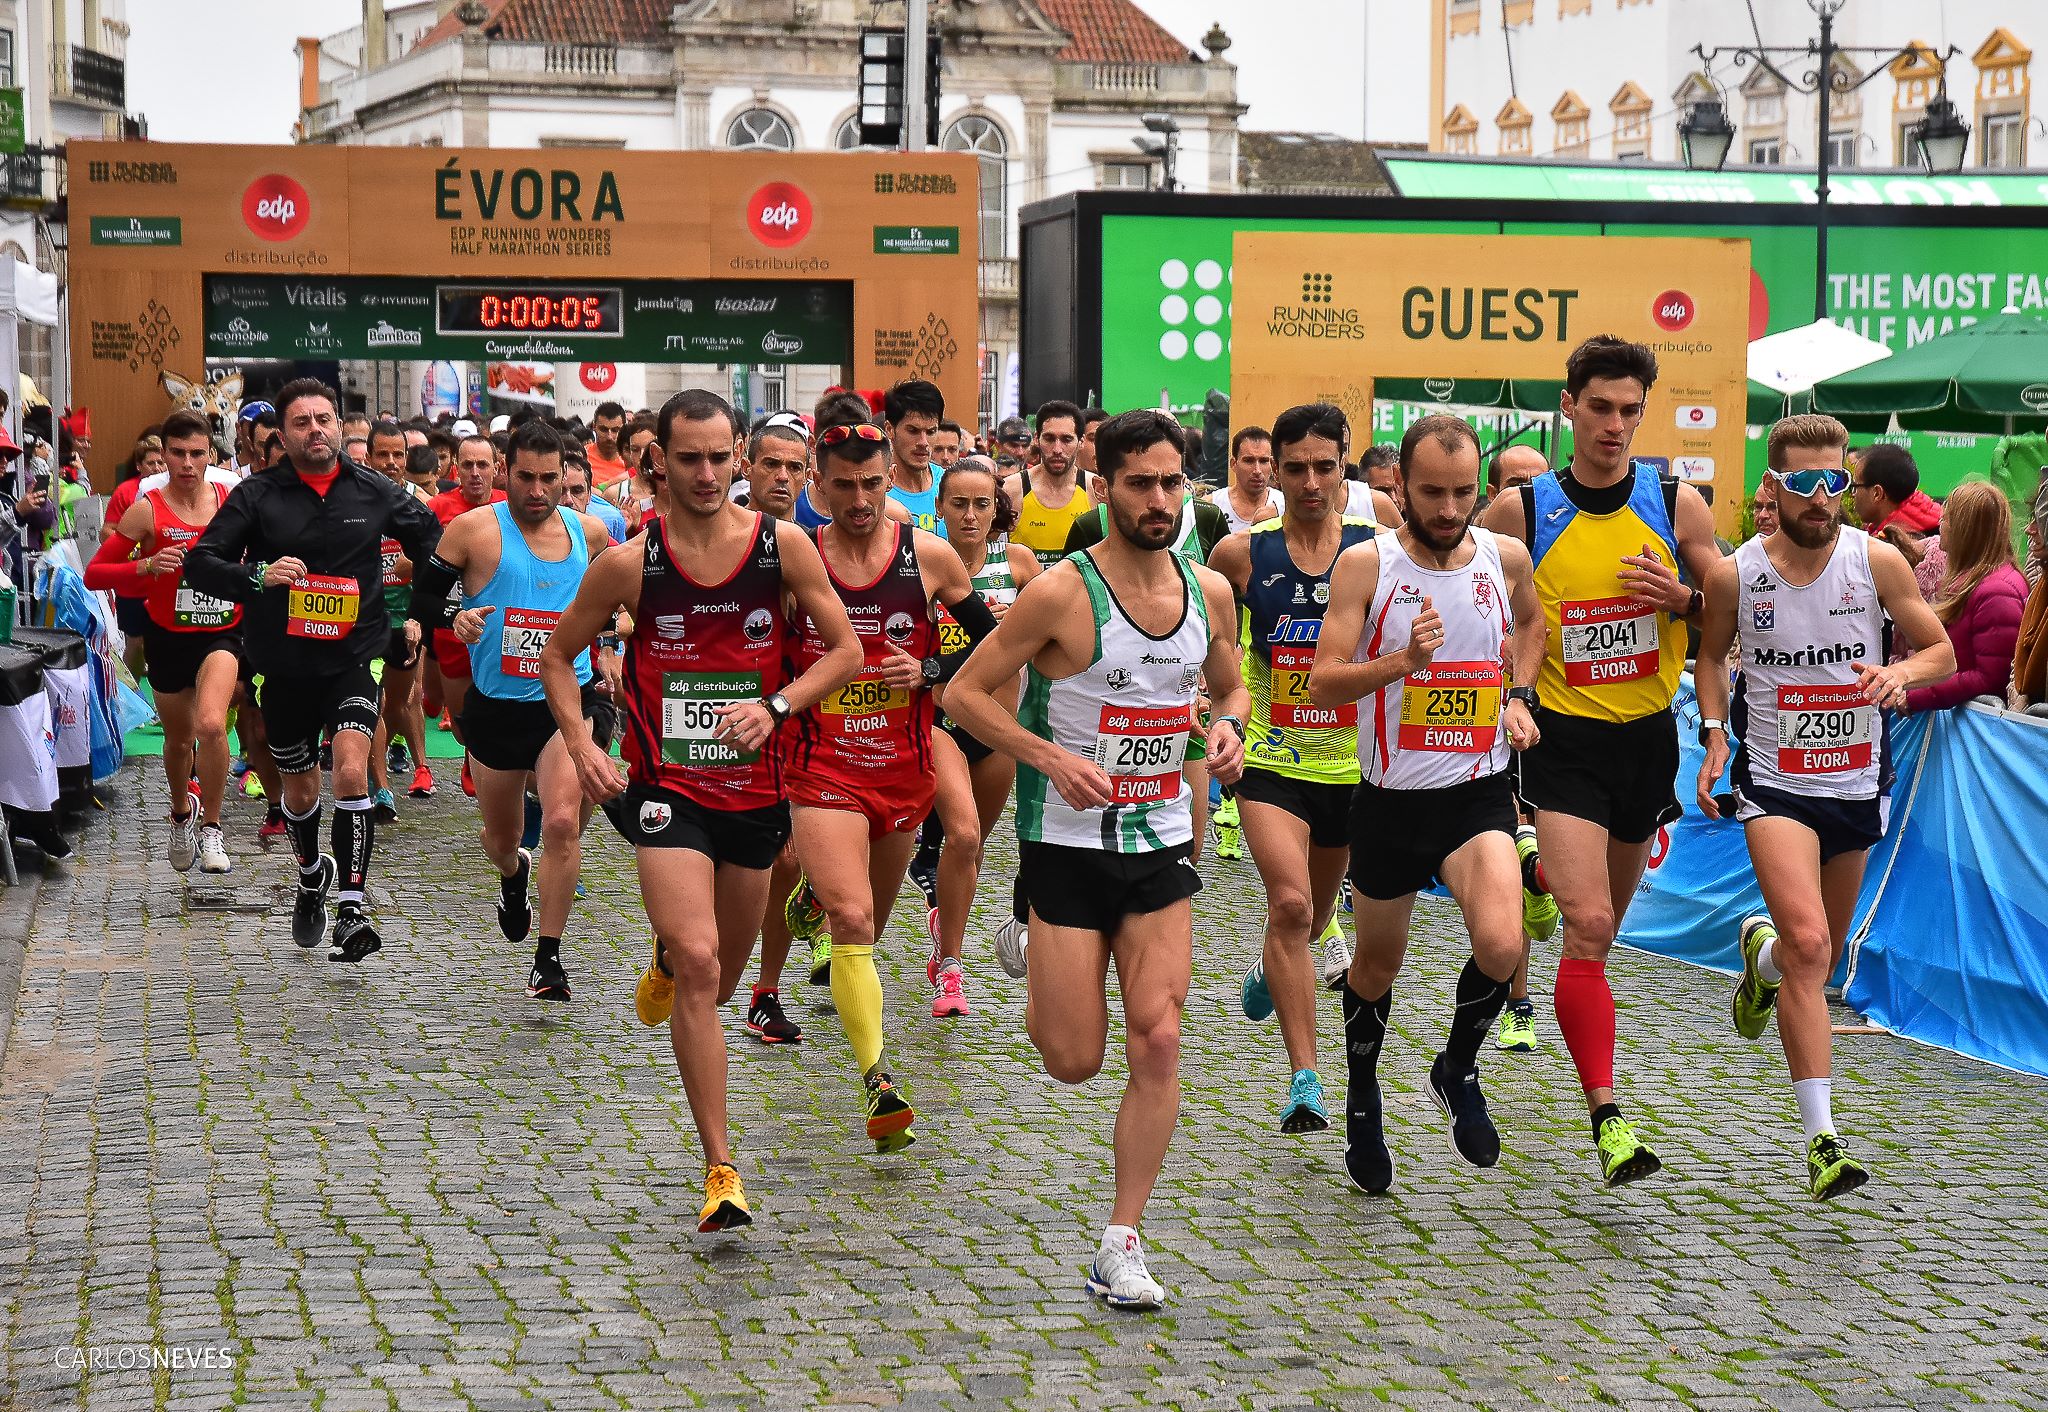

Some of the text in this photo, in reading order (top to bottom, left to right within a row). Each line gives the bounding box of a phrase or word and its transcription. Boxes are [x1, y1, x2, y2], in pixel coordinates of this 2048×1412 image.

[435, 156, 625, 222] ÉVORA
[257, 195, 295, 224] edp
[761, 202, 799, 231] edp
[451, 227, 611, 241] EDP RUNNING WONDERS
[451, 242, 611, 256] HALF MARATHON SERIES
[224, 250, 328, 269] distribuição
[729, 255, 829, 274] distribuição
[286, 284, 347, 306] Vitalis
[1829, 273, 1891, 309] THE
[1902, 273, 1996, 309] MOST
[480, 296, 602, 328] 0:00:05
[1273, 306, 1359, 323] RUNNING
[1402, 286, 1578, 342] GUEST
[1661, 302, 1686, 321] edp
[1267, 322, 1365, 339] WONDERS
[295, 338, 343, 348] CISTUS
[587, 365, 609, 383] edp
[295, 578, 310, 590] edp
[1474, 572, 1490, 581] NAC
[1751, 584, 1776, 593] VIATOR
[303, 594, 344, 615] 9001
[1754, 601, 1774, 611] CPA
[1829, 607, 1866, 617] Marinha
[191, 612, 223, 625] ÉVORA
[509, 613, 559, 626] edp distribu
[1567, 607, 1588, 622] edp
[304, 621, 340, 636] ÉVORA
[1585, 620, 1638, 652] 2041
[651, 642, 696, 652] SEAT
[1591, 650, 1612, 660] Bruno
[1754, 642, 1867, 667] Marinha
[1277, 653, 1296, 666] edp
[1411, 668, 1496, 684] edp distribuição
[1591, 659, 1639, 680] ÉVORA
[669, 680, 757, 695] edp distribuição
[838, 680, 891, 707] 2566
[1425, 690, 1478, 717] 2351
[1784, 692, 1805, 706] edp
[845, 714, 889, 733] ÉVORA
[1107, 714, 1187, 730] edp distribuição
[1293, 705, 1338, 724] ÉVORA
[1425, 717, 1444, 725] Nuno
[1797, 711, 1856, 741] 2390
[1424, 727, 1474, 748] ÉVORA
[1116, 736, 1174, 767] 2695
[1804, 750, 1851, 769] ÉVORA
[1118, 777, 1161, 798] ÉVORA
